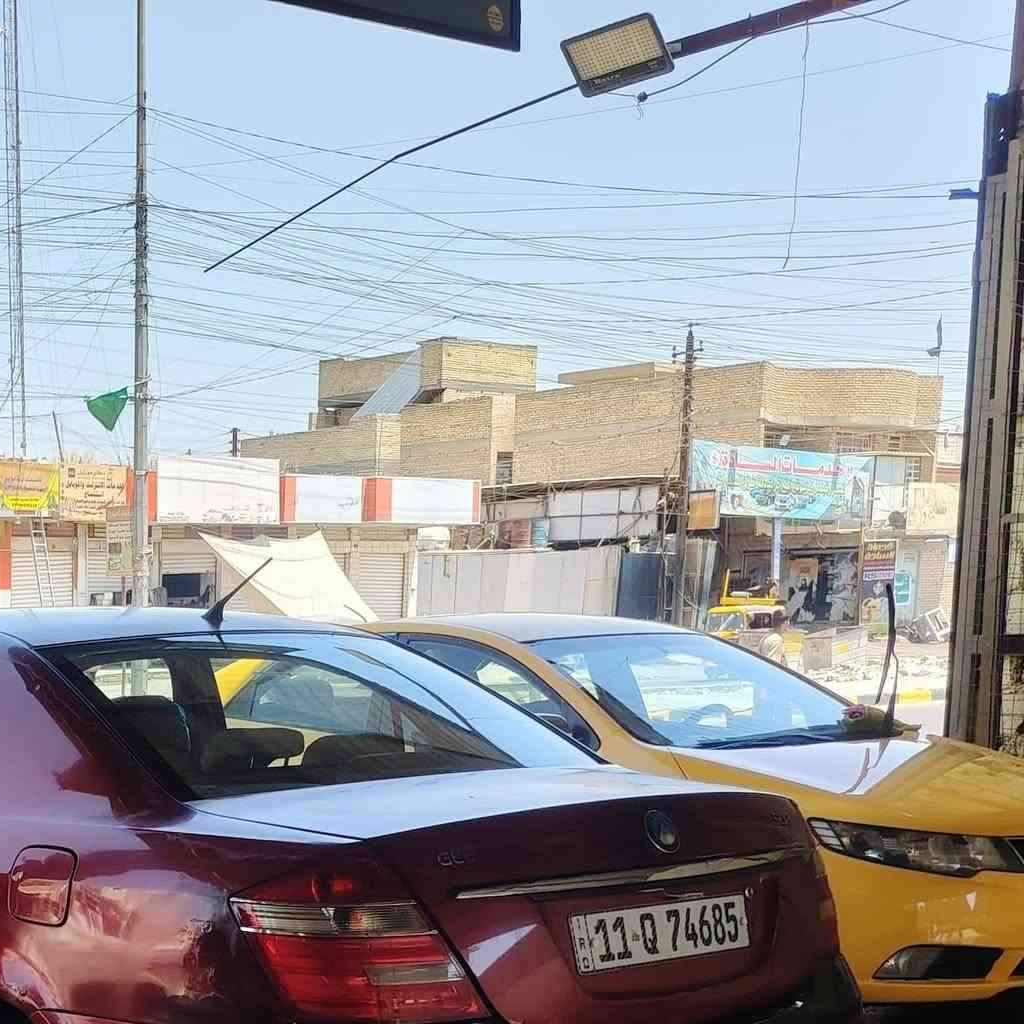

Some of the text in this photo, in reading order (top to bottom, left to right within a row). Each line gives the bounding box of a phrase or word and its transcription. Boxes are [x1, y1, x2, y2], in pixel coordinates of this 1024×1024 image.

[594, 902, 739, 962] 11 Q 74685
